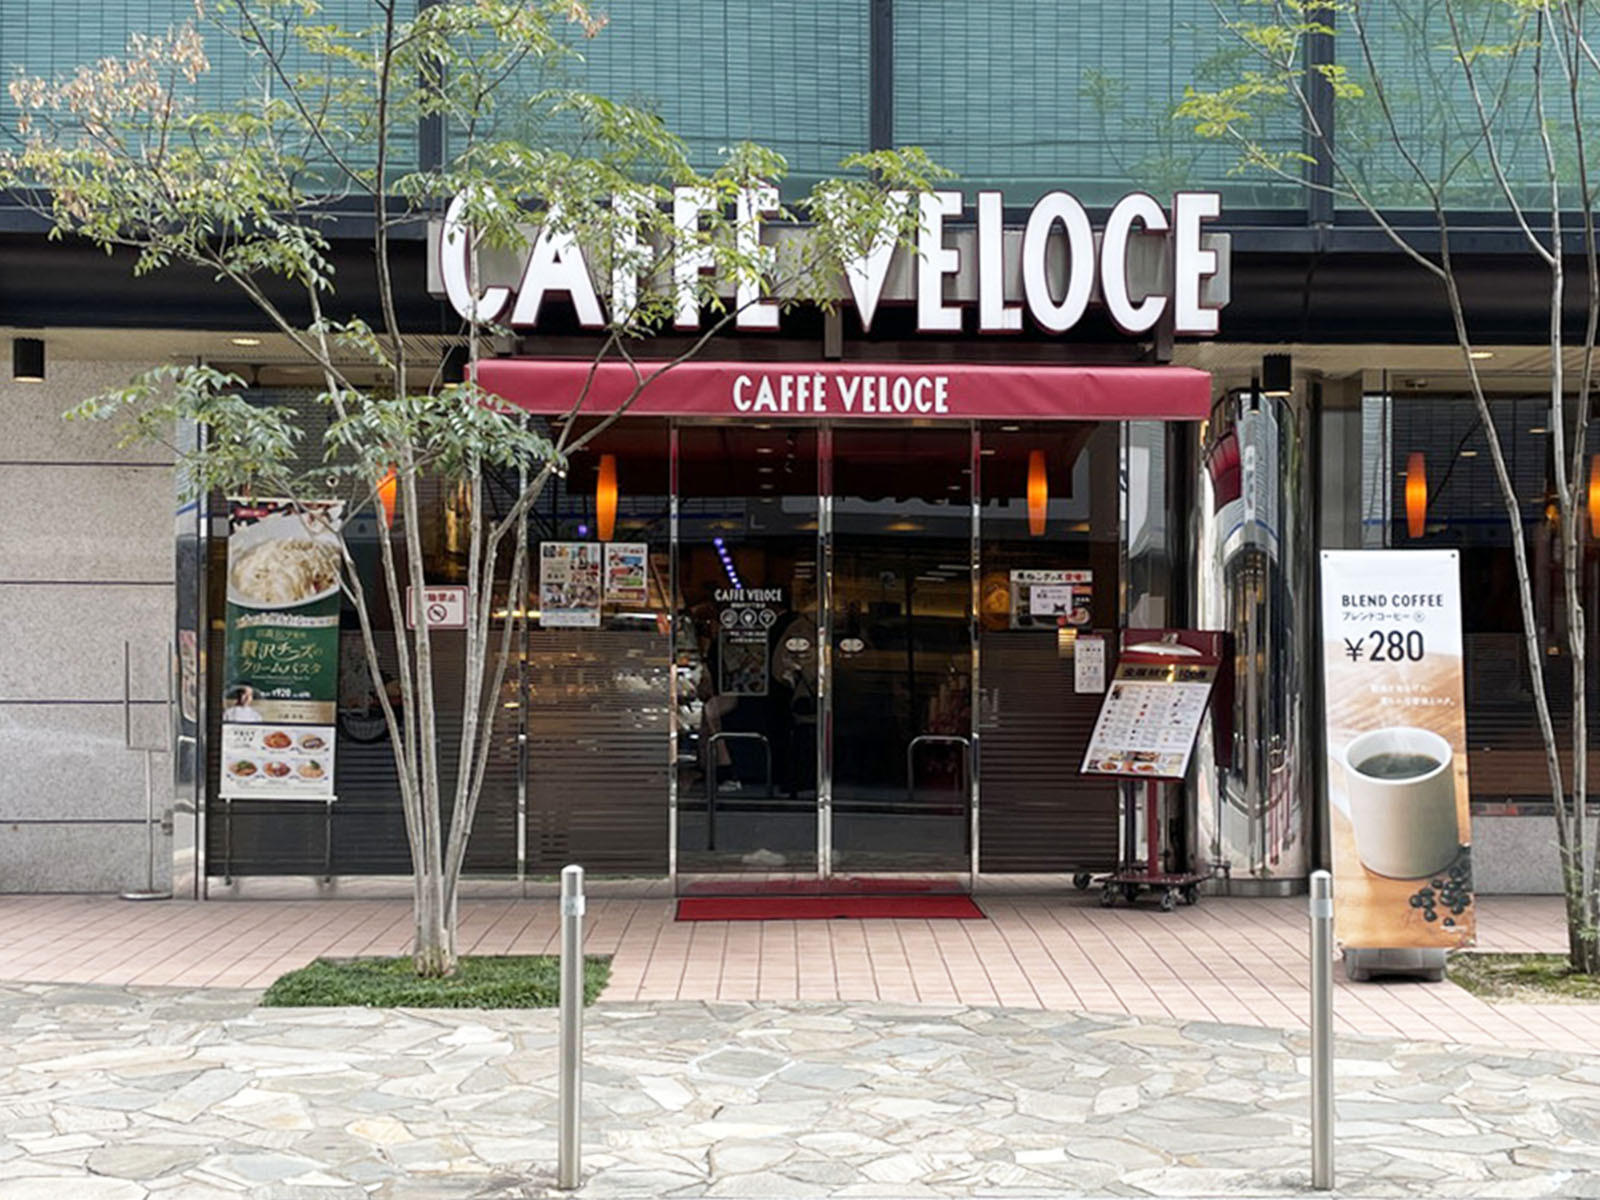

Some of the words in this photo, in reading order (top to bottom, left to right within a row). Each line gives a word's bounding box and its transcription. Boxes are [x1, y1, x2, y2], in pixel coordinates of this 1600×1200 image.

[824, 189, 1221, 333] VELOCE
[733, 372, 827, 412] CAFFÈ
[835, 375, 949, 413] VELOCE
[1341, 594, 1387, 607] BLEND
[1391, 594, 1444, 607] COFFEE
[1344, 630, 1425, 662] ¥280
